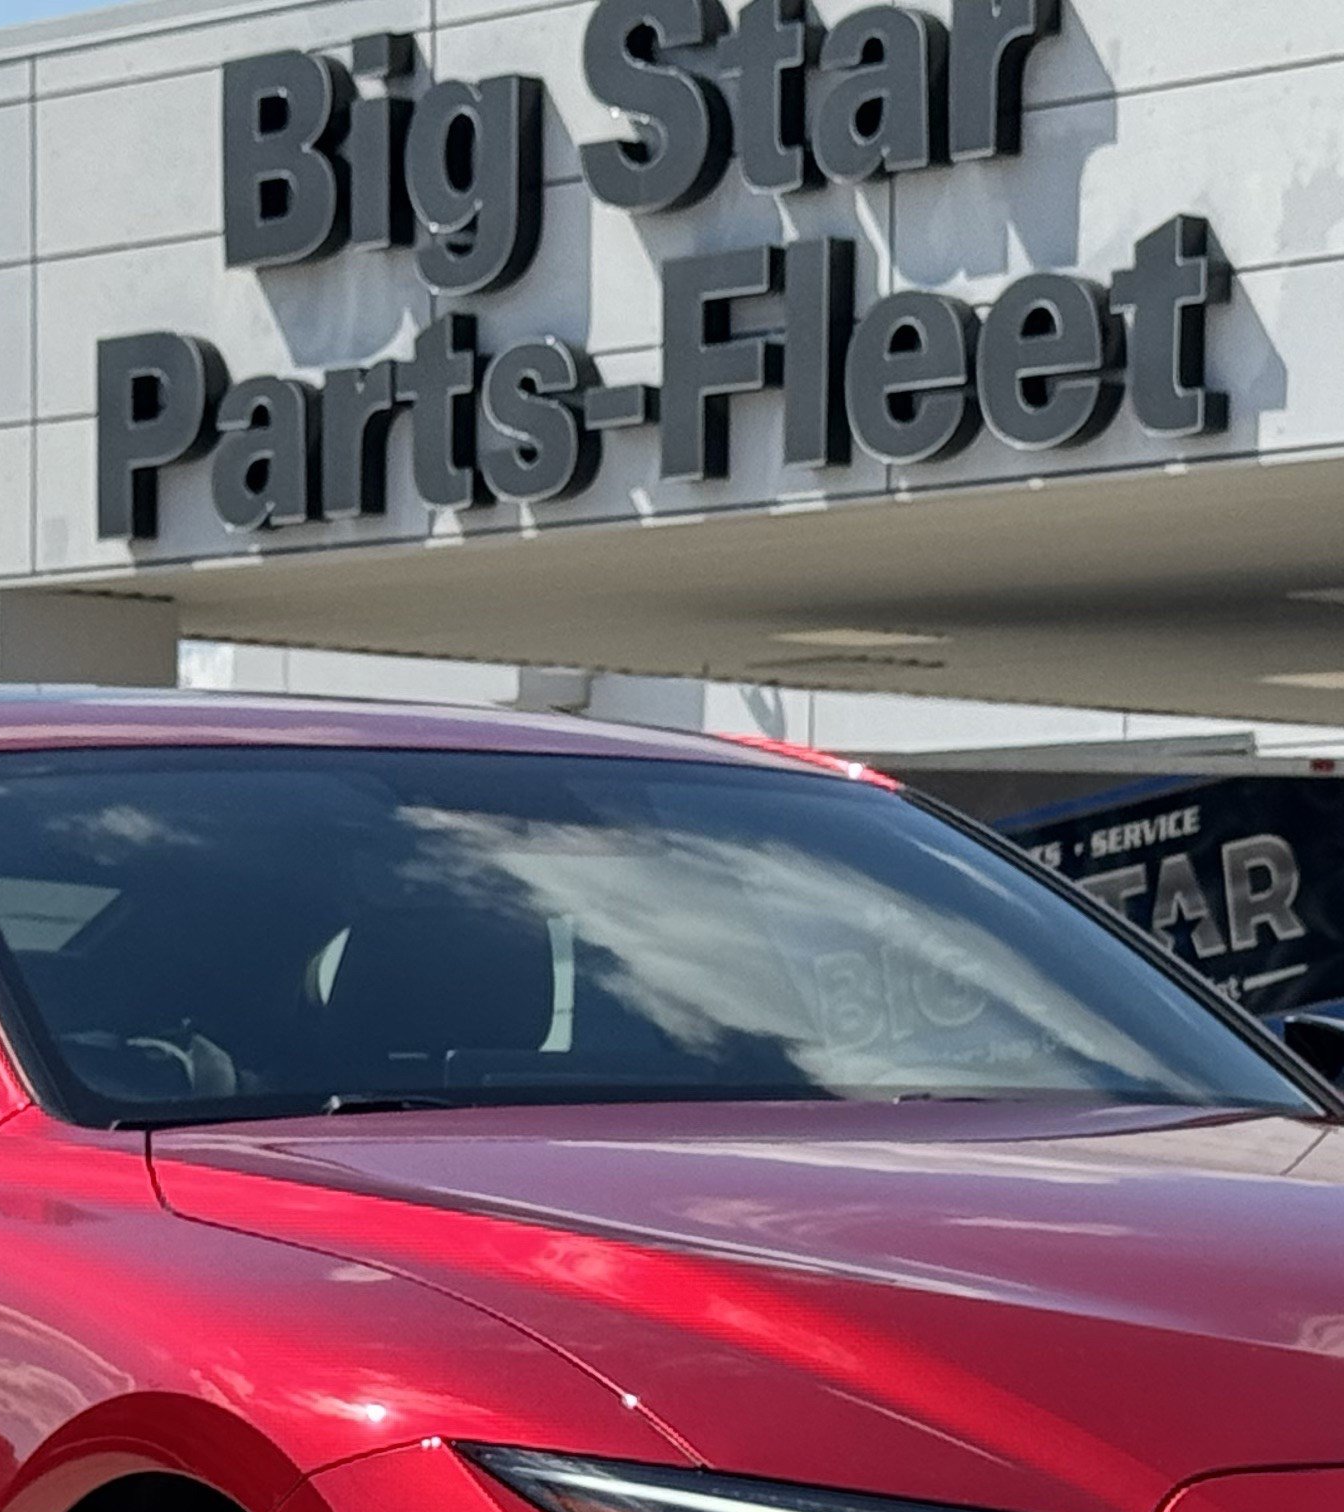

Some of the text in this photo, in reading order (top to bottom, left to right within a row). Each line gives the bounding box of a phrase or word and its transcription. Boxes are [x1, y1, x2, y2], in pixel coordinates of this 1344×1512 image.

[221, 0, 1058, 296] Big Star
[96, 214, 1230, 542] Parts-Fleet
[1090, 805, 1202, 858] SERVICE
